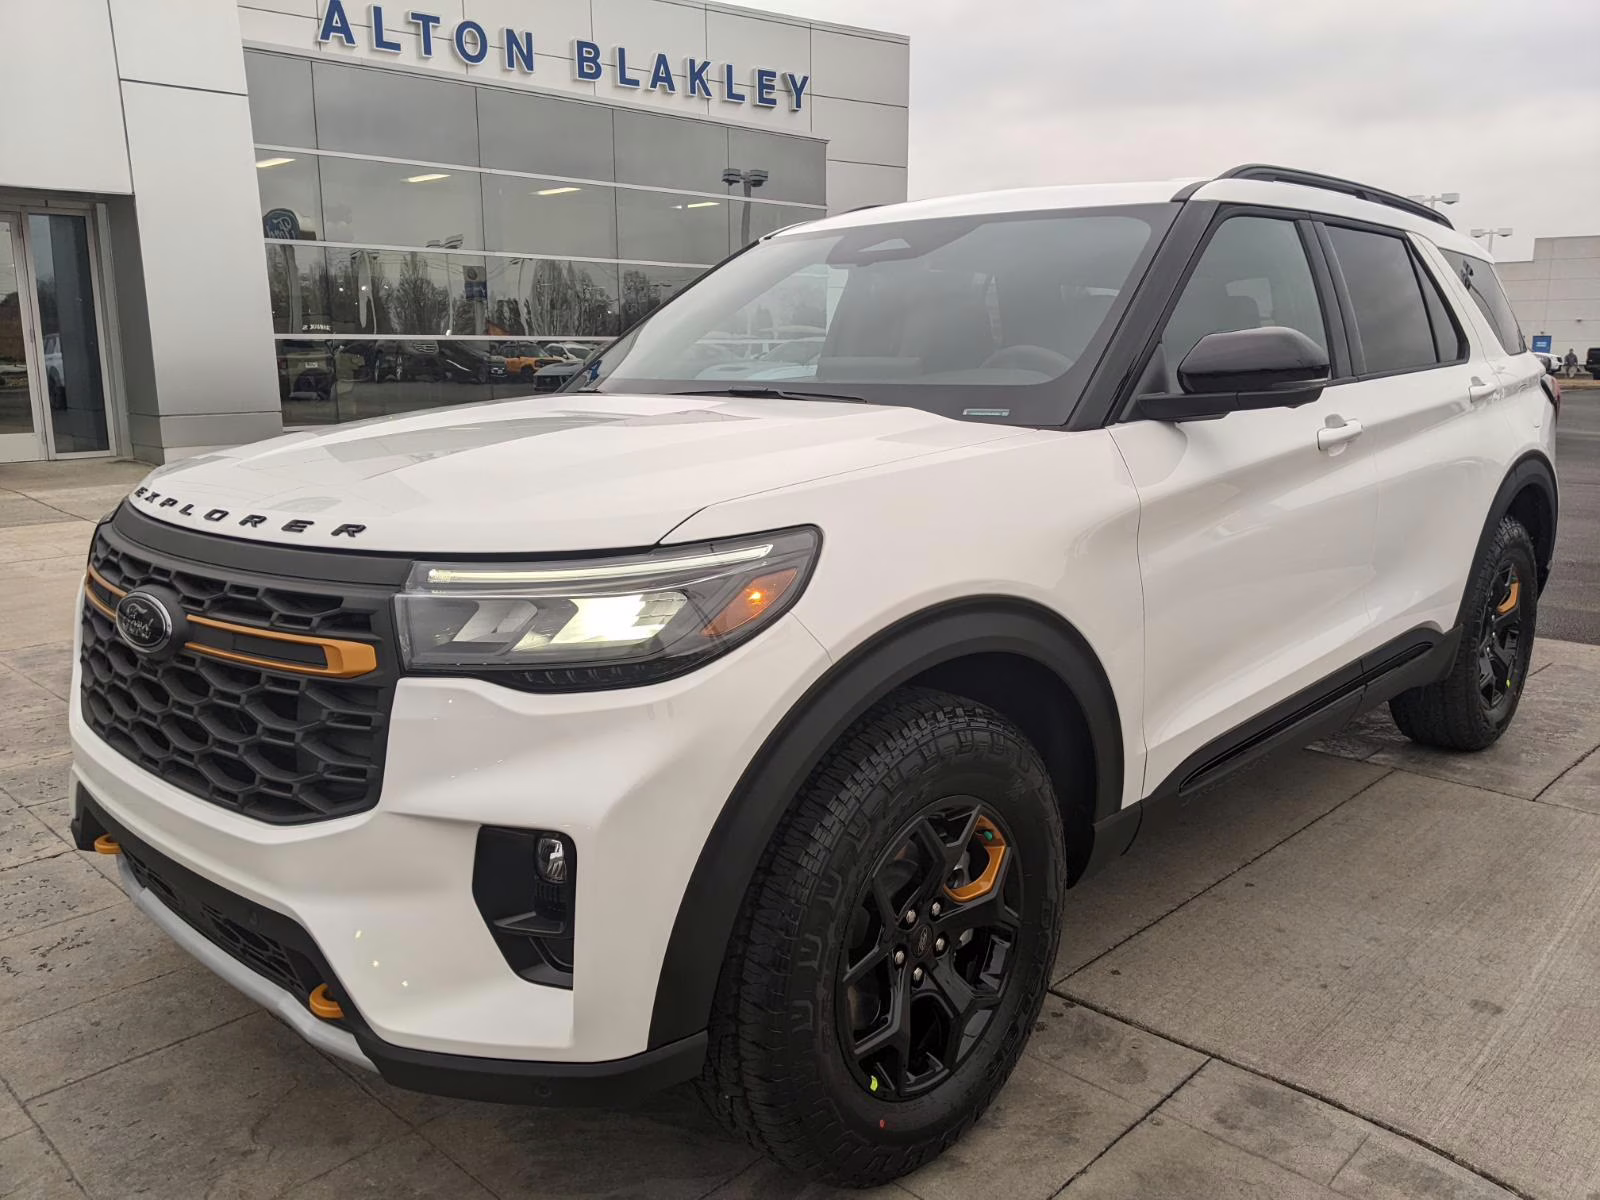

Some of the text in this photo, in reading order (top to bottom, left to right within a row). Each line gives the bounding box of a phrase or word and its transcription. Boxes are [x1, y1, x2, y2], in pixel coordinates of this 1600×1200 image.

[319, 0, 810, 111] ALTON BLAKLEY
[134, 486, 367, 538] EXPLORER
